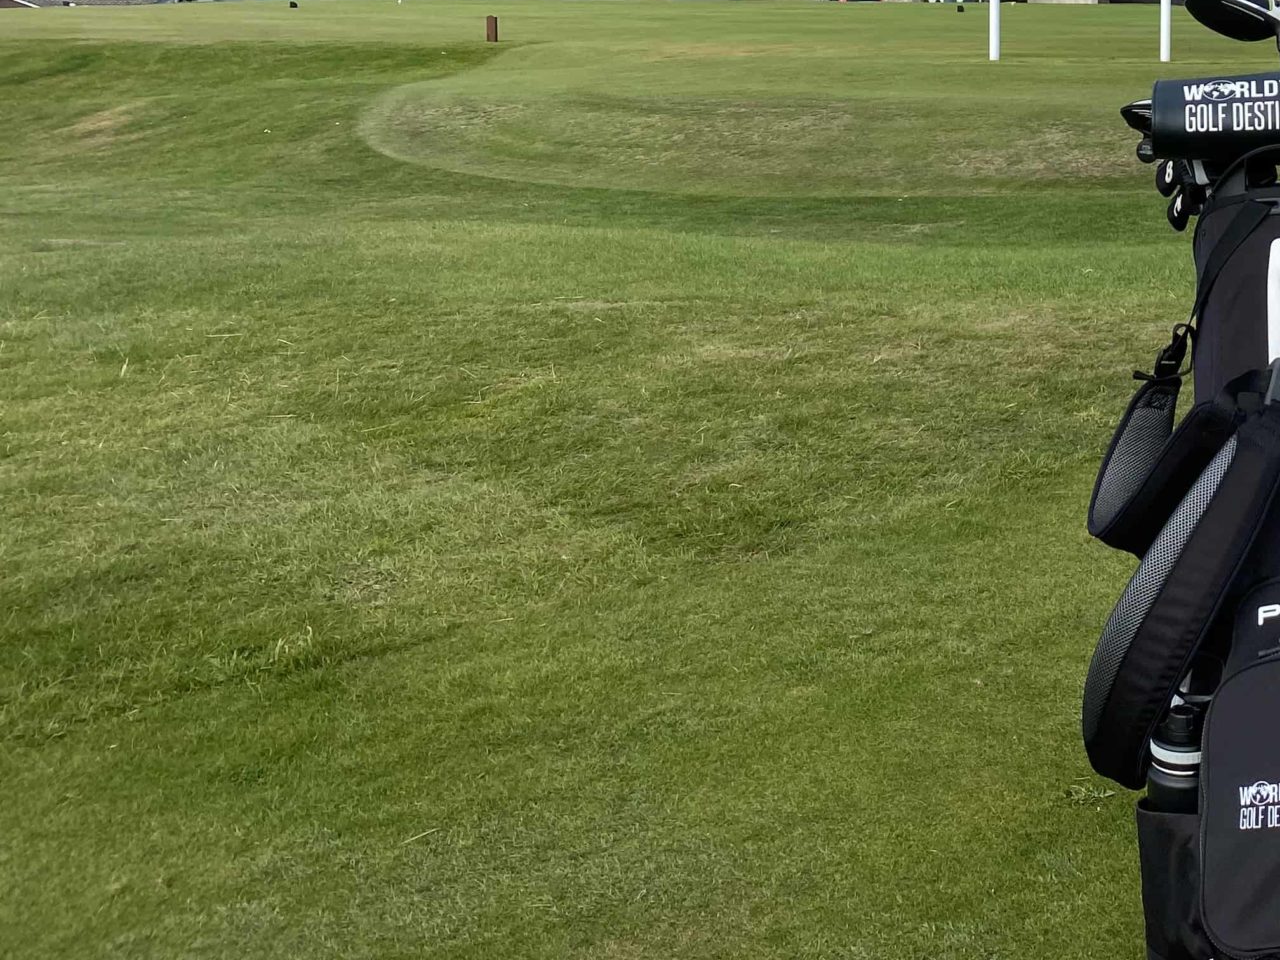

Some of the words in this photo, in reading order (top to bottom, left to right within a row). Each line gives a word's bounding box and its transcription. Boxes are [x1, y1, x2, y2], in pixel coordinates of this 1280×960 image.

[1185, 103, 1226, 133] GOLF
[1165, 160, 1174, 184] 8
[1240, 806, 1266, 830] GOLF
